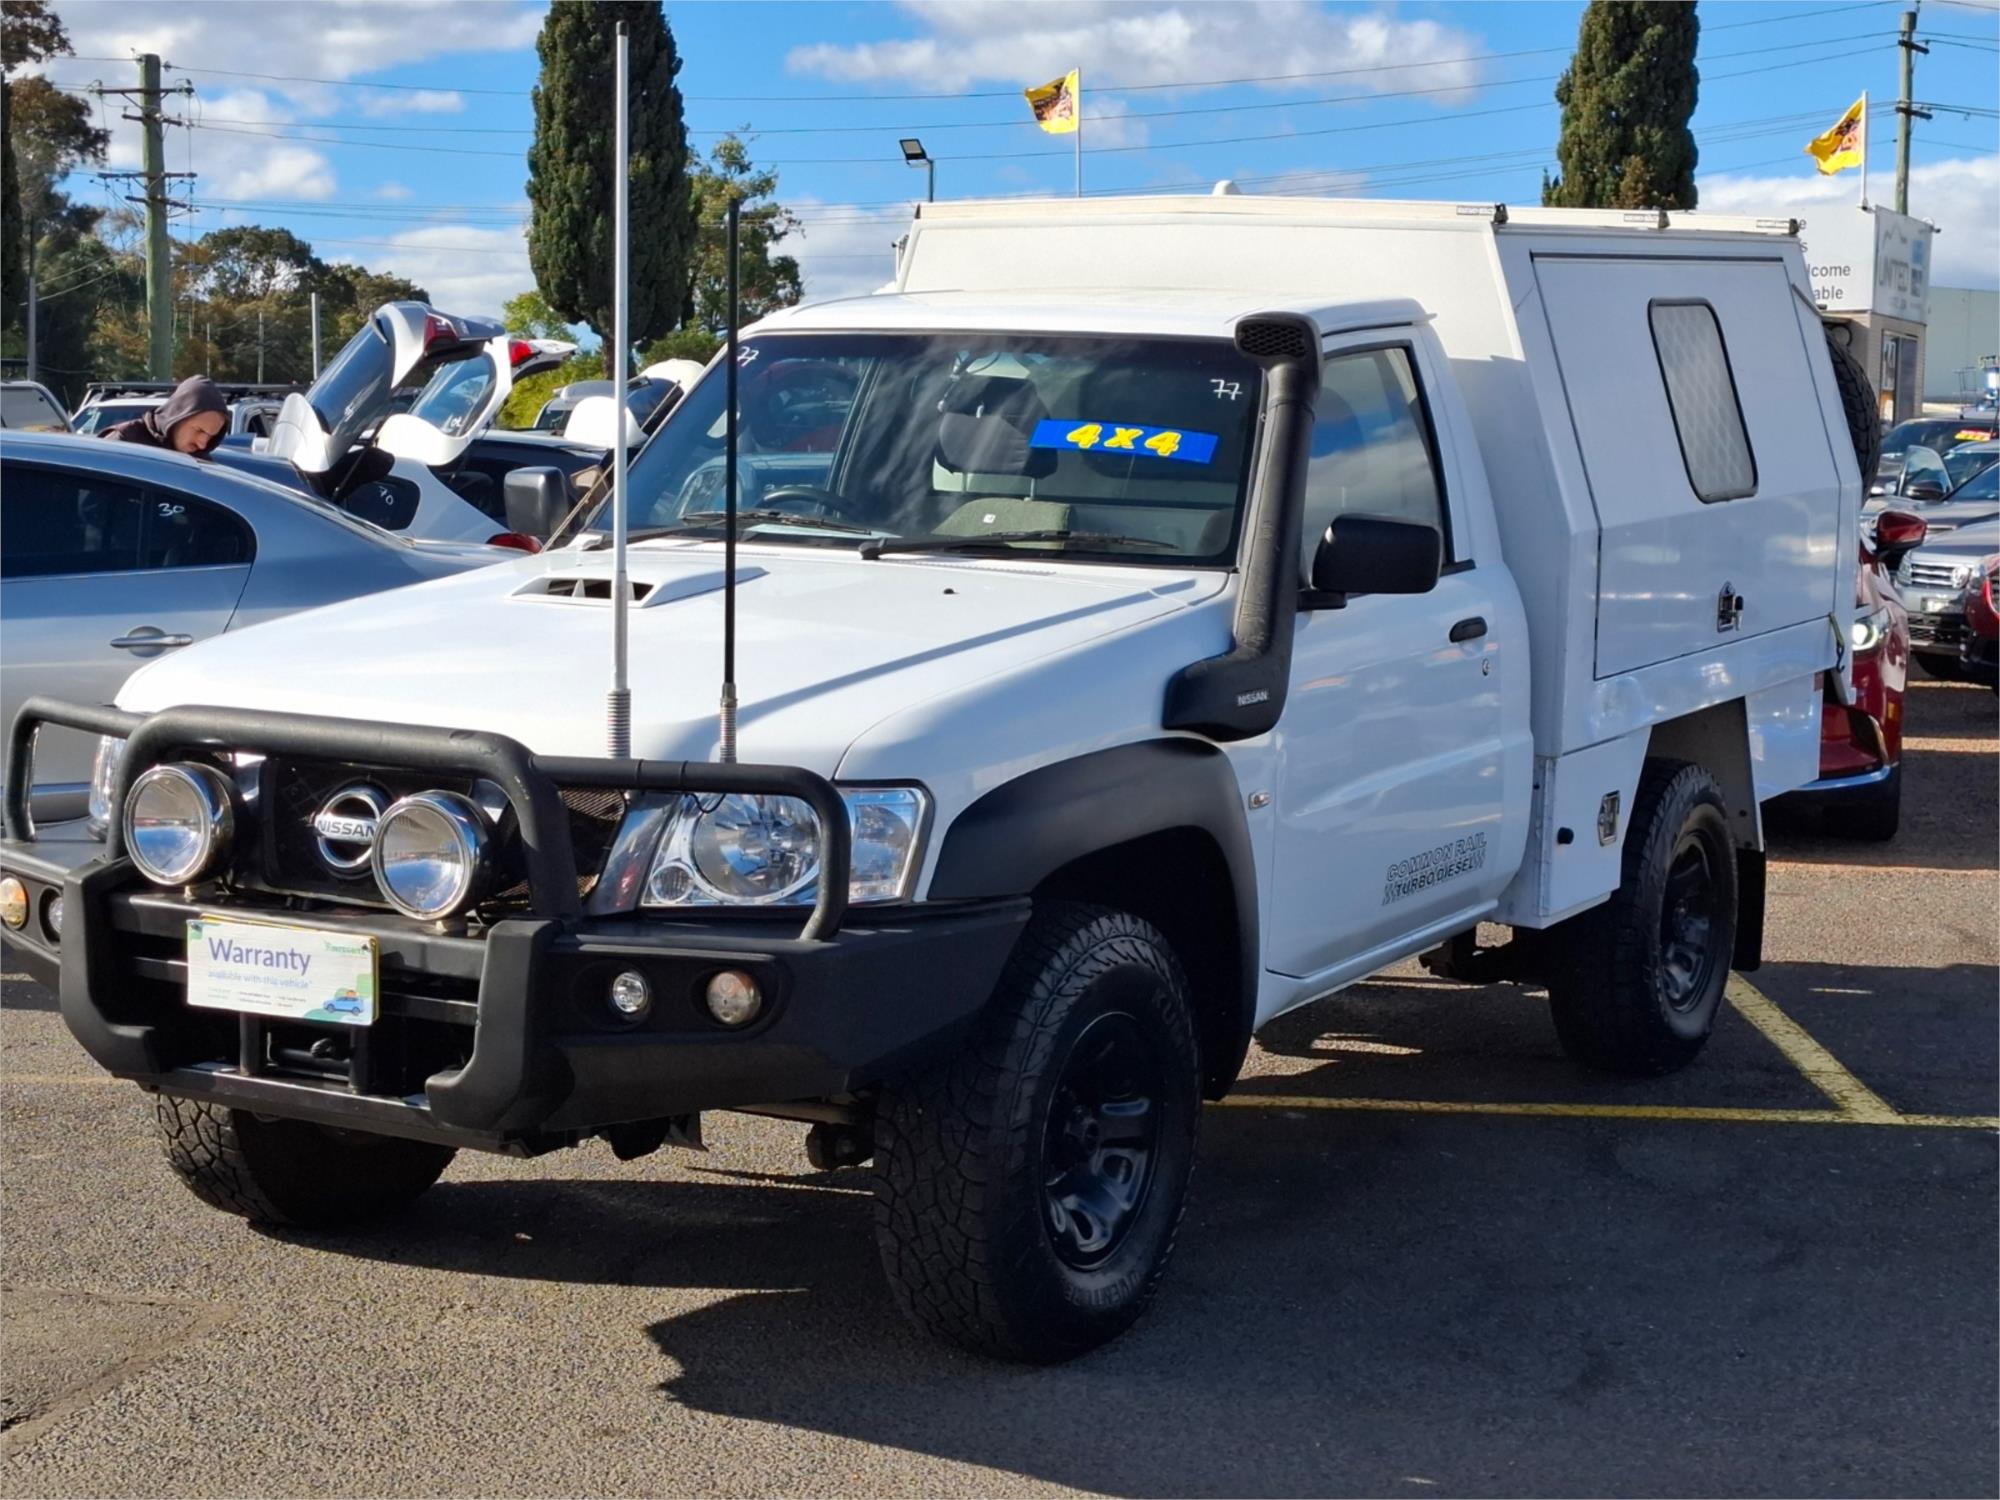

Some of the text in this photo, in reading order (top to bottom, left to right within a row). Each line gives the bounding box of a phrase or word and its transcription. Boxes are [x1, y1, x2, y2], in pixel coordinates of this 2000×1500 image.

[1210, 378, 1243, 401] 77
[378, 485, 394, 506] 70
[158, 502, 186, 517] 30
[1237, 689, 1269, 707] NISSAN
[317, 819, 376, 838] NISSAN
[1387, 843, 1453, 882] COMMON
[208, 937, 311, 976] Warranty
